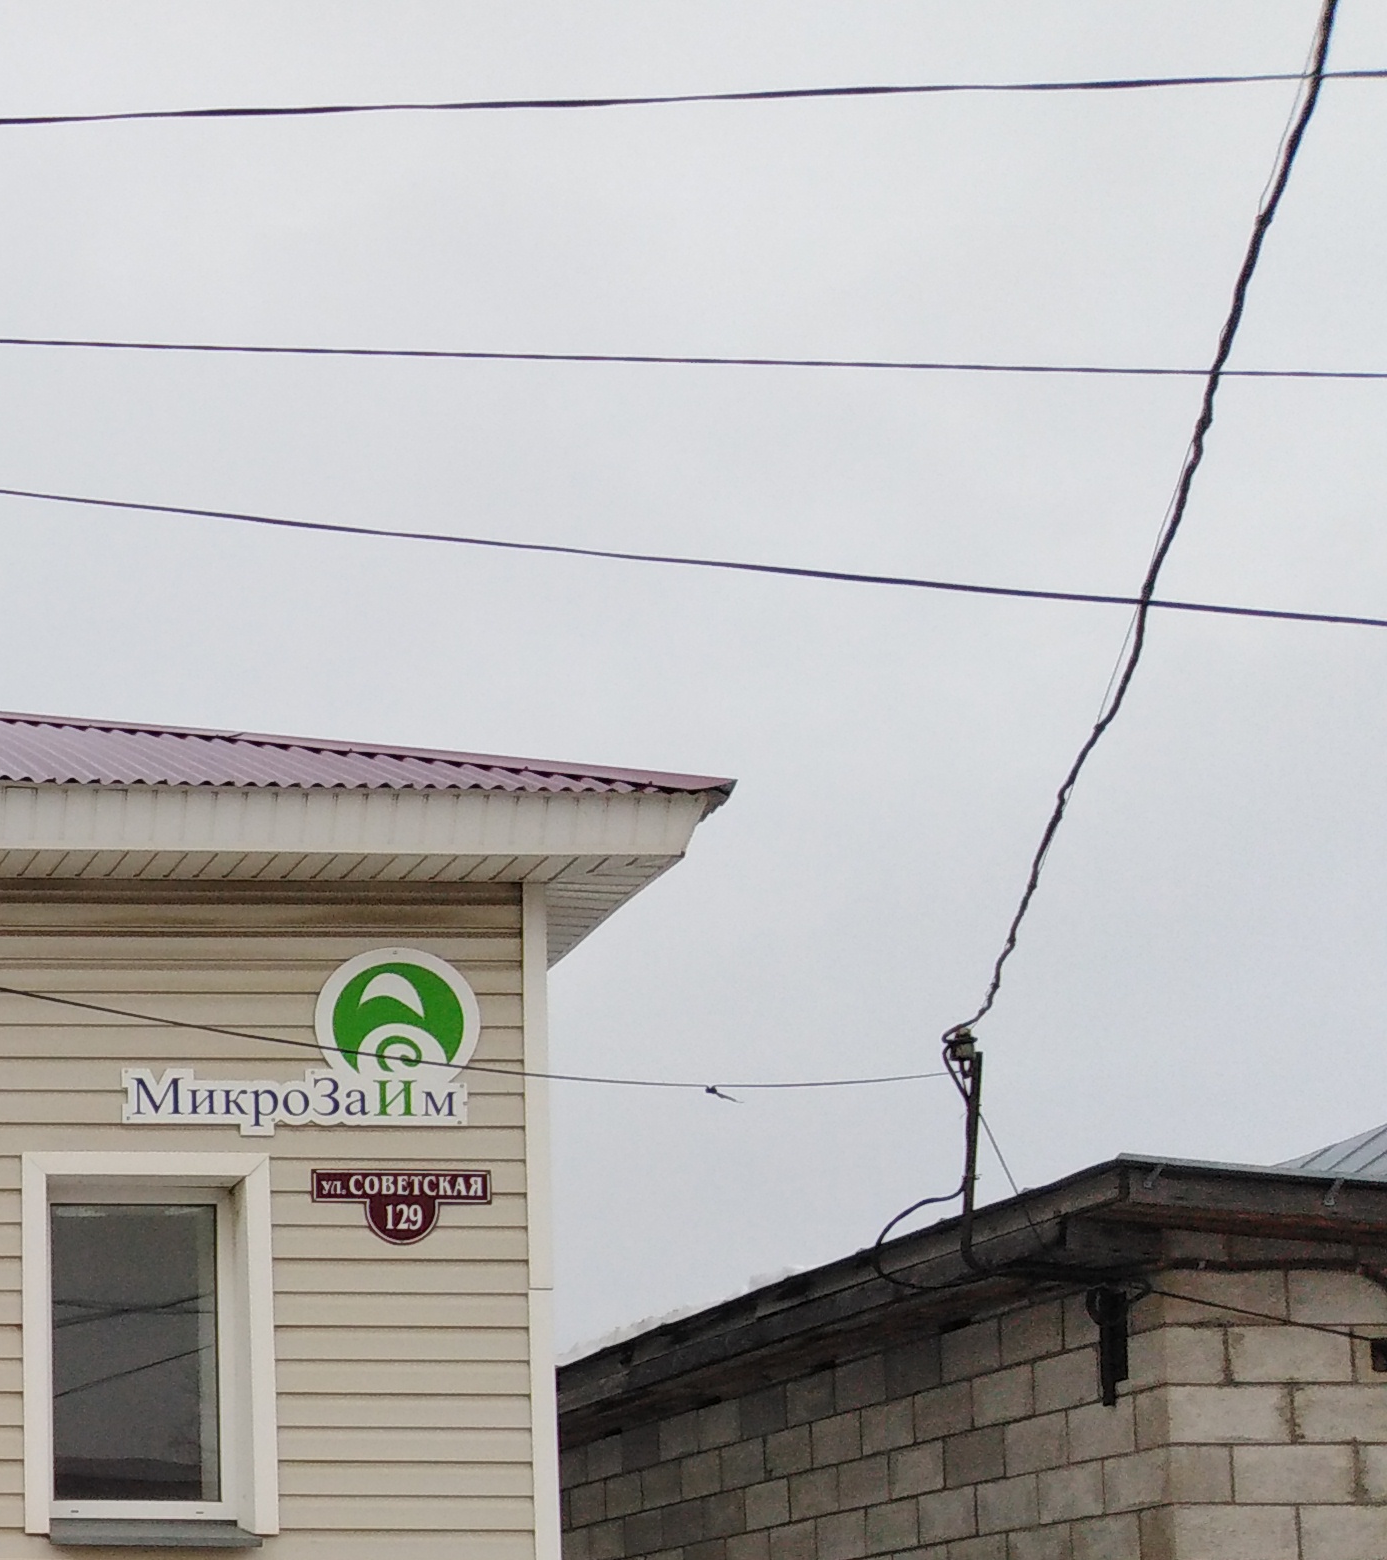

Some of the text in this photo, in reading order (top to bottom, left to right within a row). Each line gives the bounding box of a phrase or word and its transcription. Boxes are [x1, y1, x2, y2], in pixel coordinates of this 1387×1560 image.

[320, 1174, 483, 1198] ул. СОВЕТСКАЯ
[385, 1204, 424, 1231] 129
